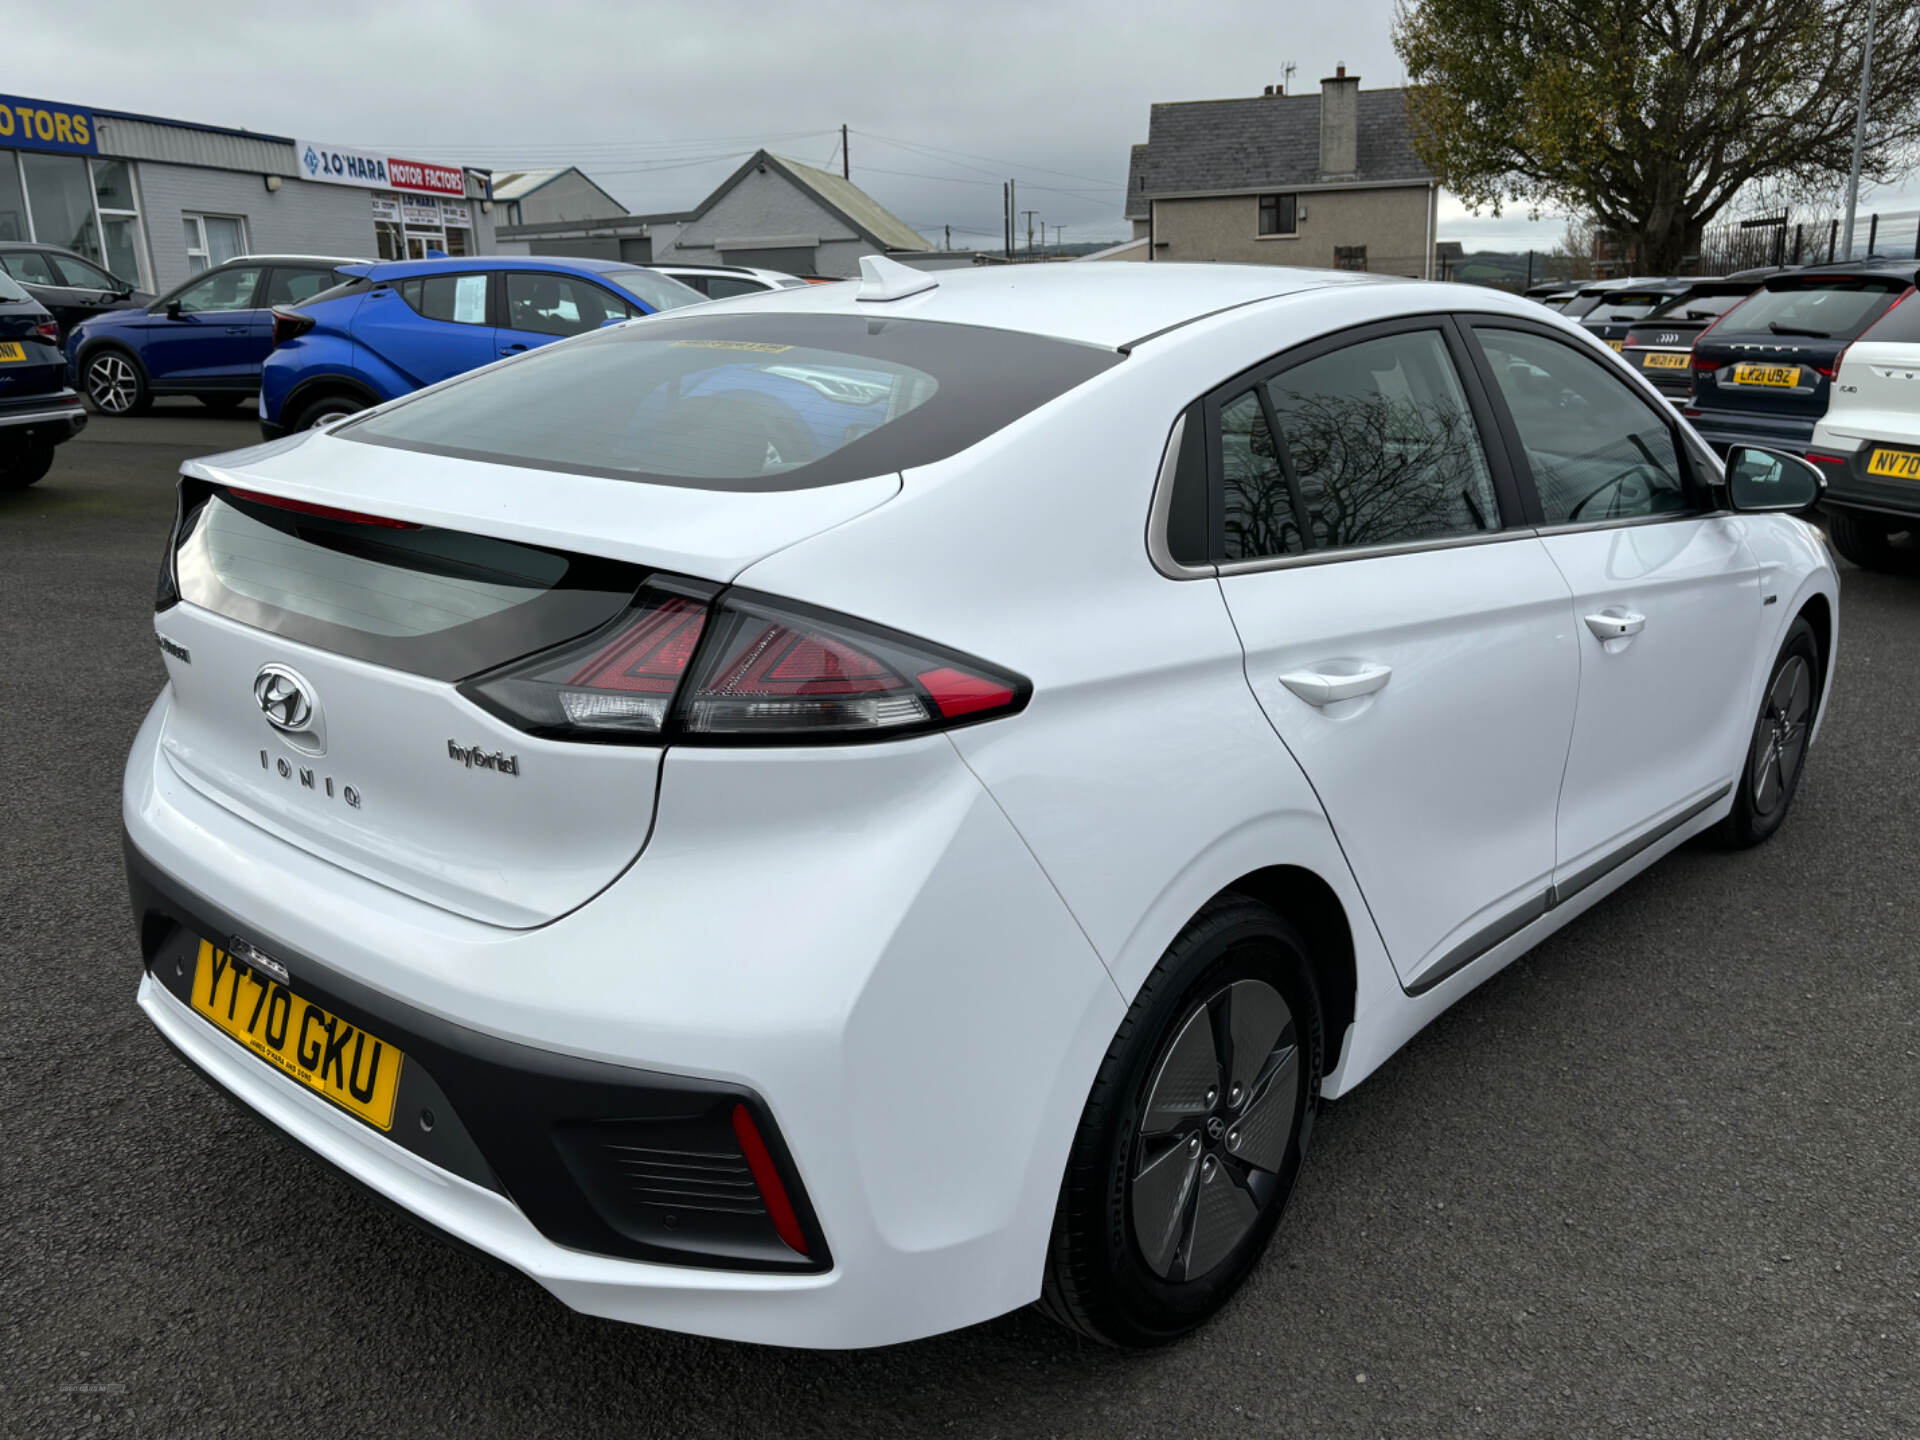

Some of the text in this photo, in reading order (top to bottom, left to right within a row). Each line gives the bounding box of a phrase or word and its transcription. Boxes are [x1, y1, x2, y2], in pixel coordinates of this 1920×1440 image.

[0, 103, 90, 145] OTORS
[390, 164, 462, 191] MOTOR FACTORS
[1875, 451, 1920, 476] NV70
[447, 738, 520, 776] hybrid
[260, 749, 361, 809] IONIQ
[208, 944, 382, 1104] YT70 GKU
[285, 1061, 297, 1072] AND
[297, 1068, 312, 1082] SONS
